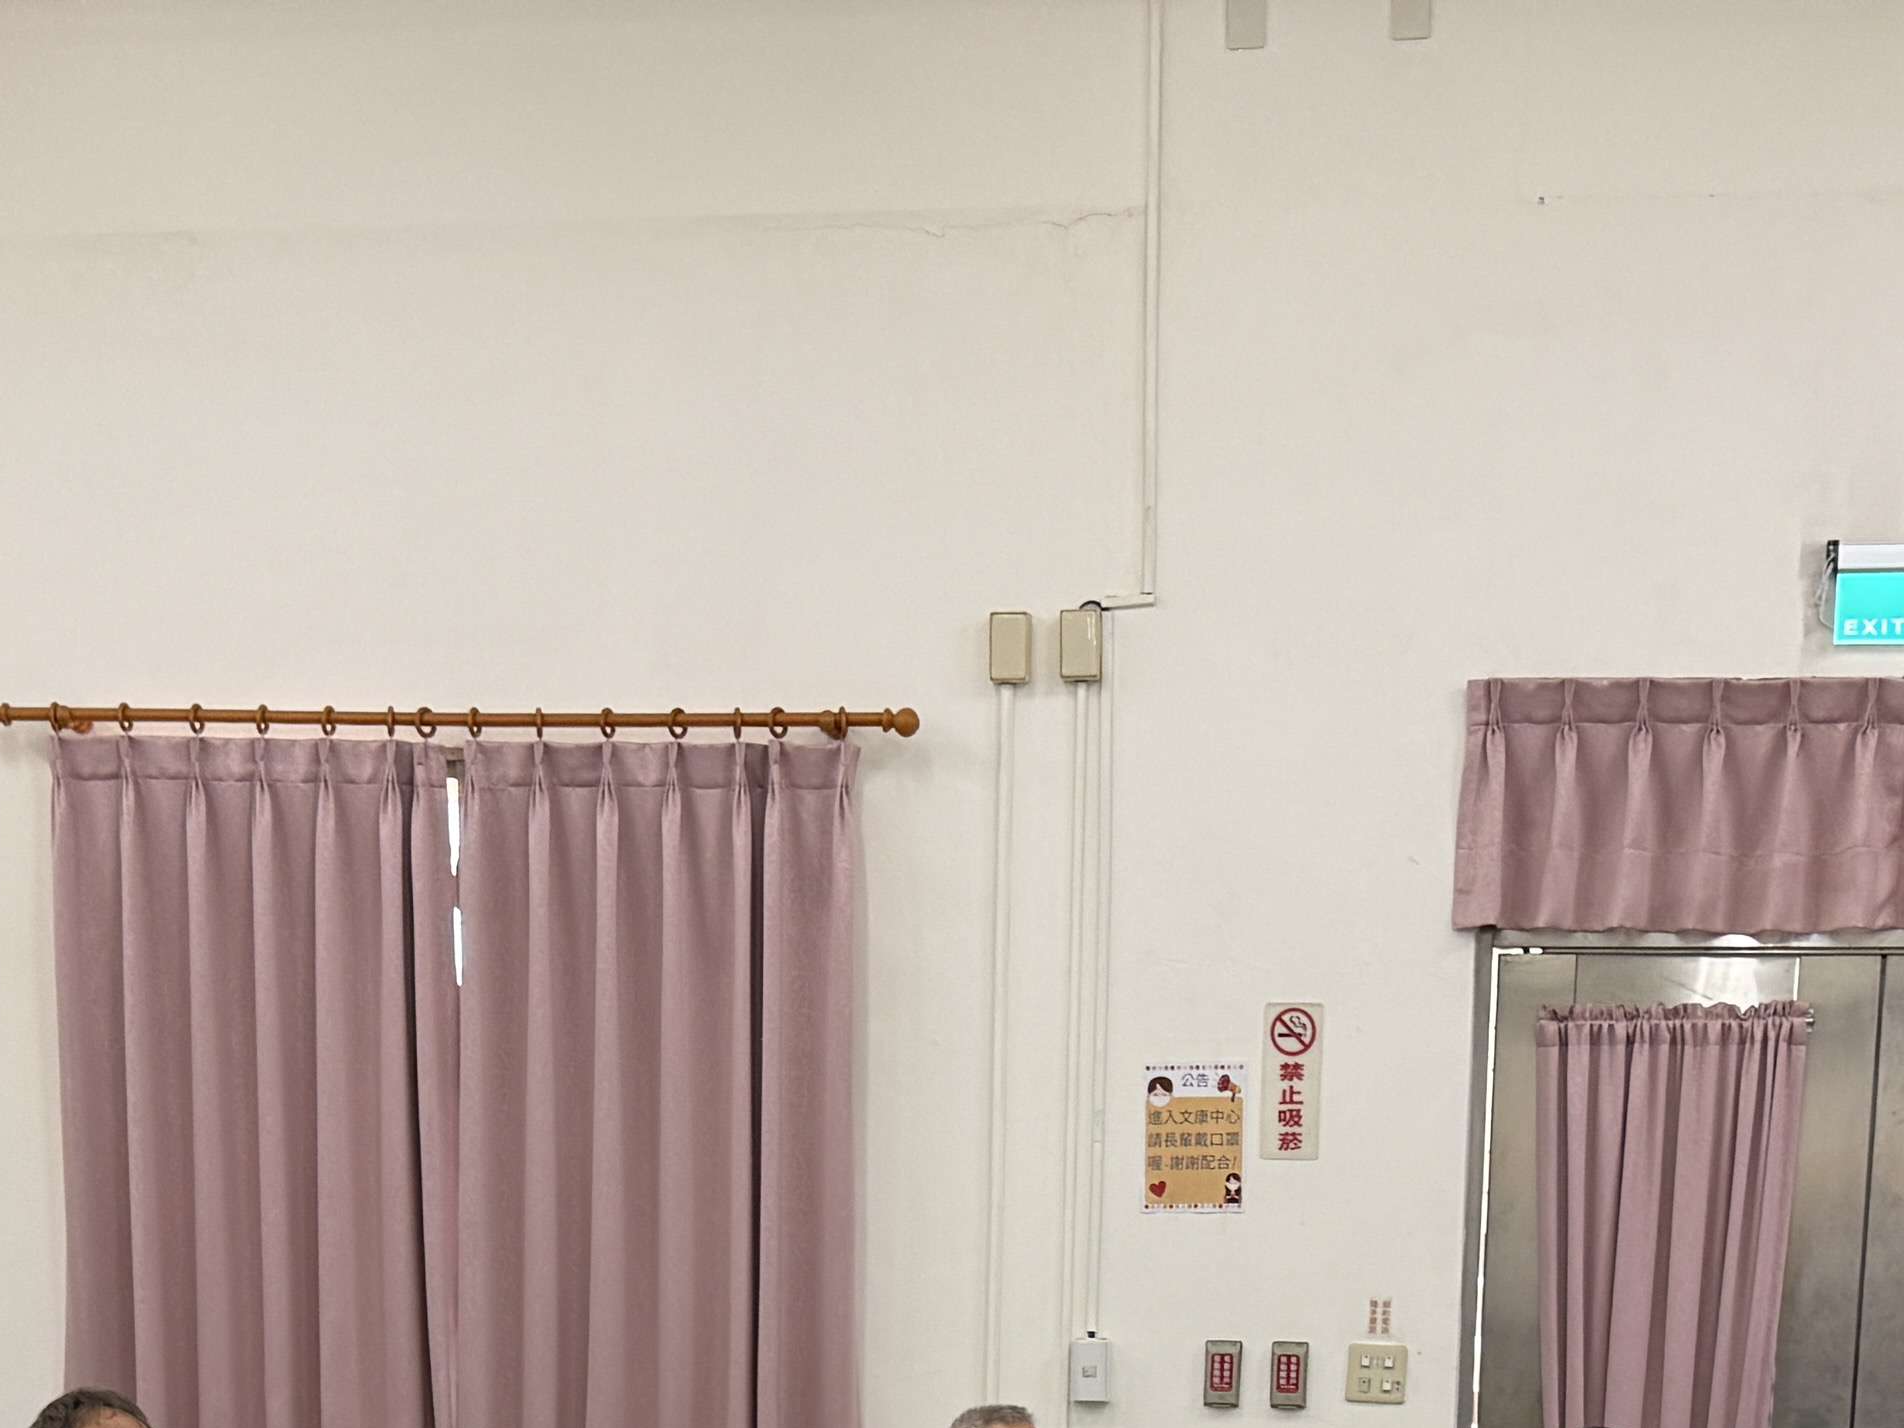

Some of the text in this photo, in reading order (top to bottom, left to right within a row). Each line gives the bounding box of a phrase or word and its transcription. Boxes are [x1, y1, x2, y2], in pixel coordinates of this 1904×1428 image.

[1181, 1073, 1210, 1088] 公告
[1277, 1061, 1305, 1151] 禁止吸菸
[1147, 1131, 1241, 1148] 請長輩戴口罩
